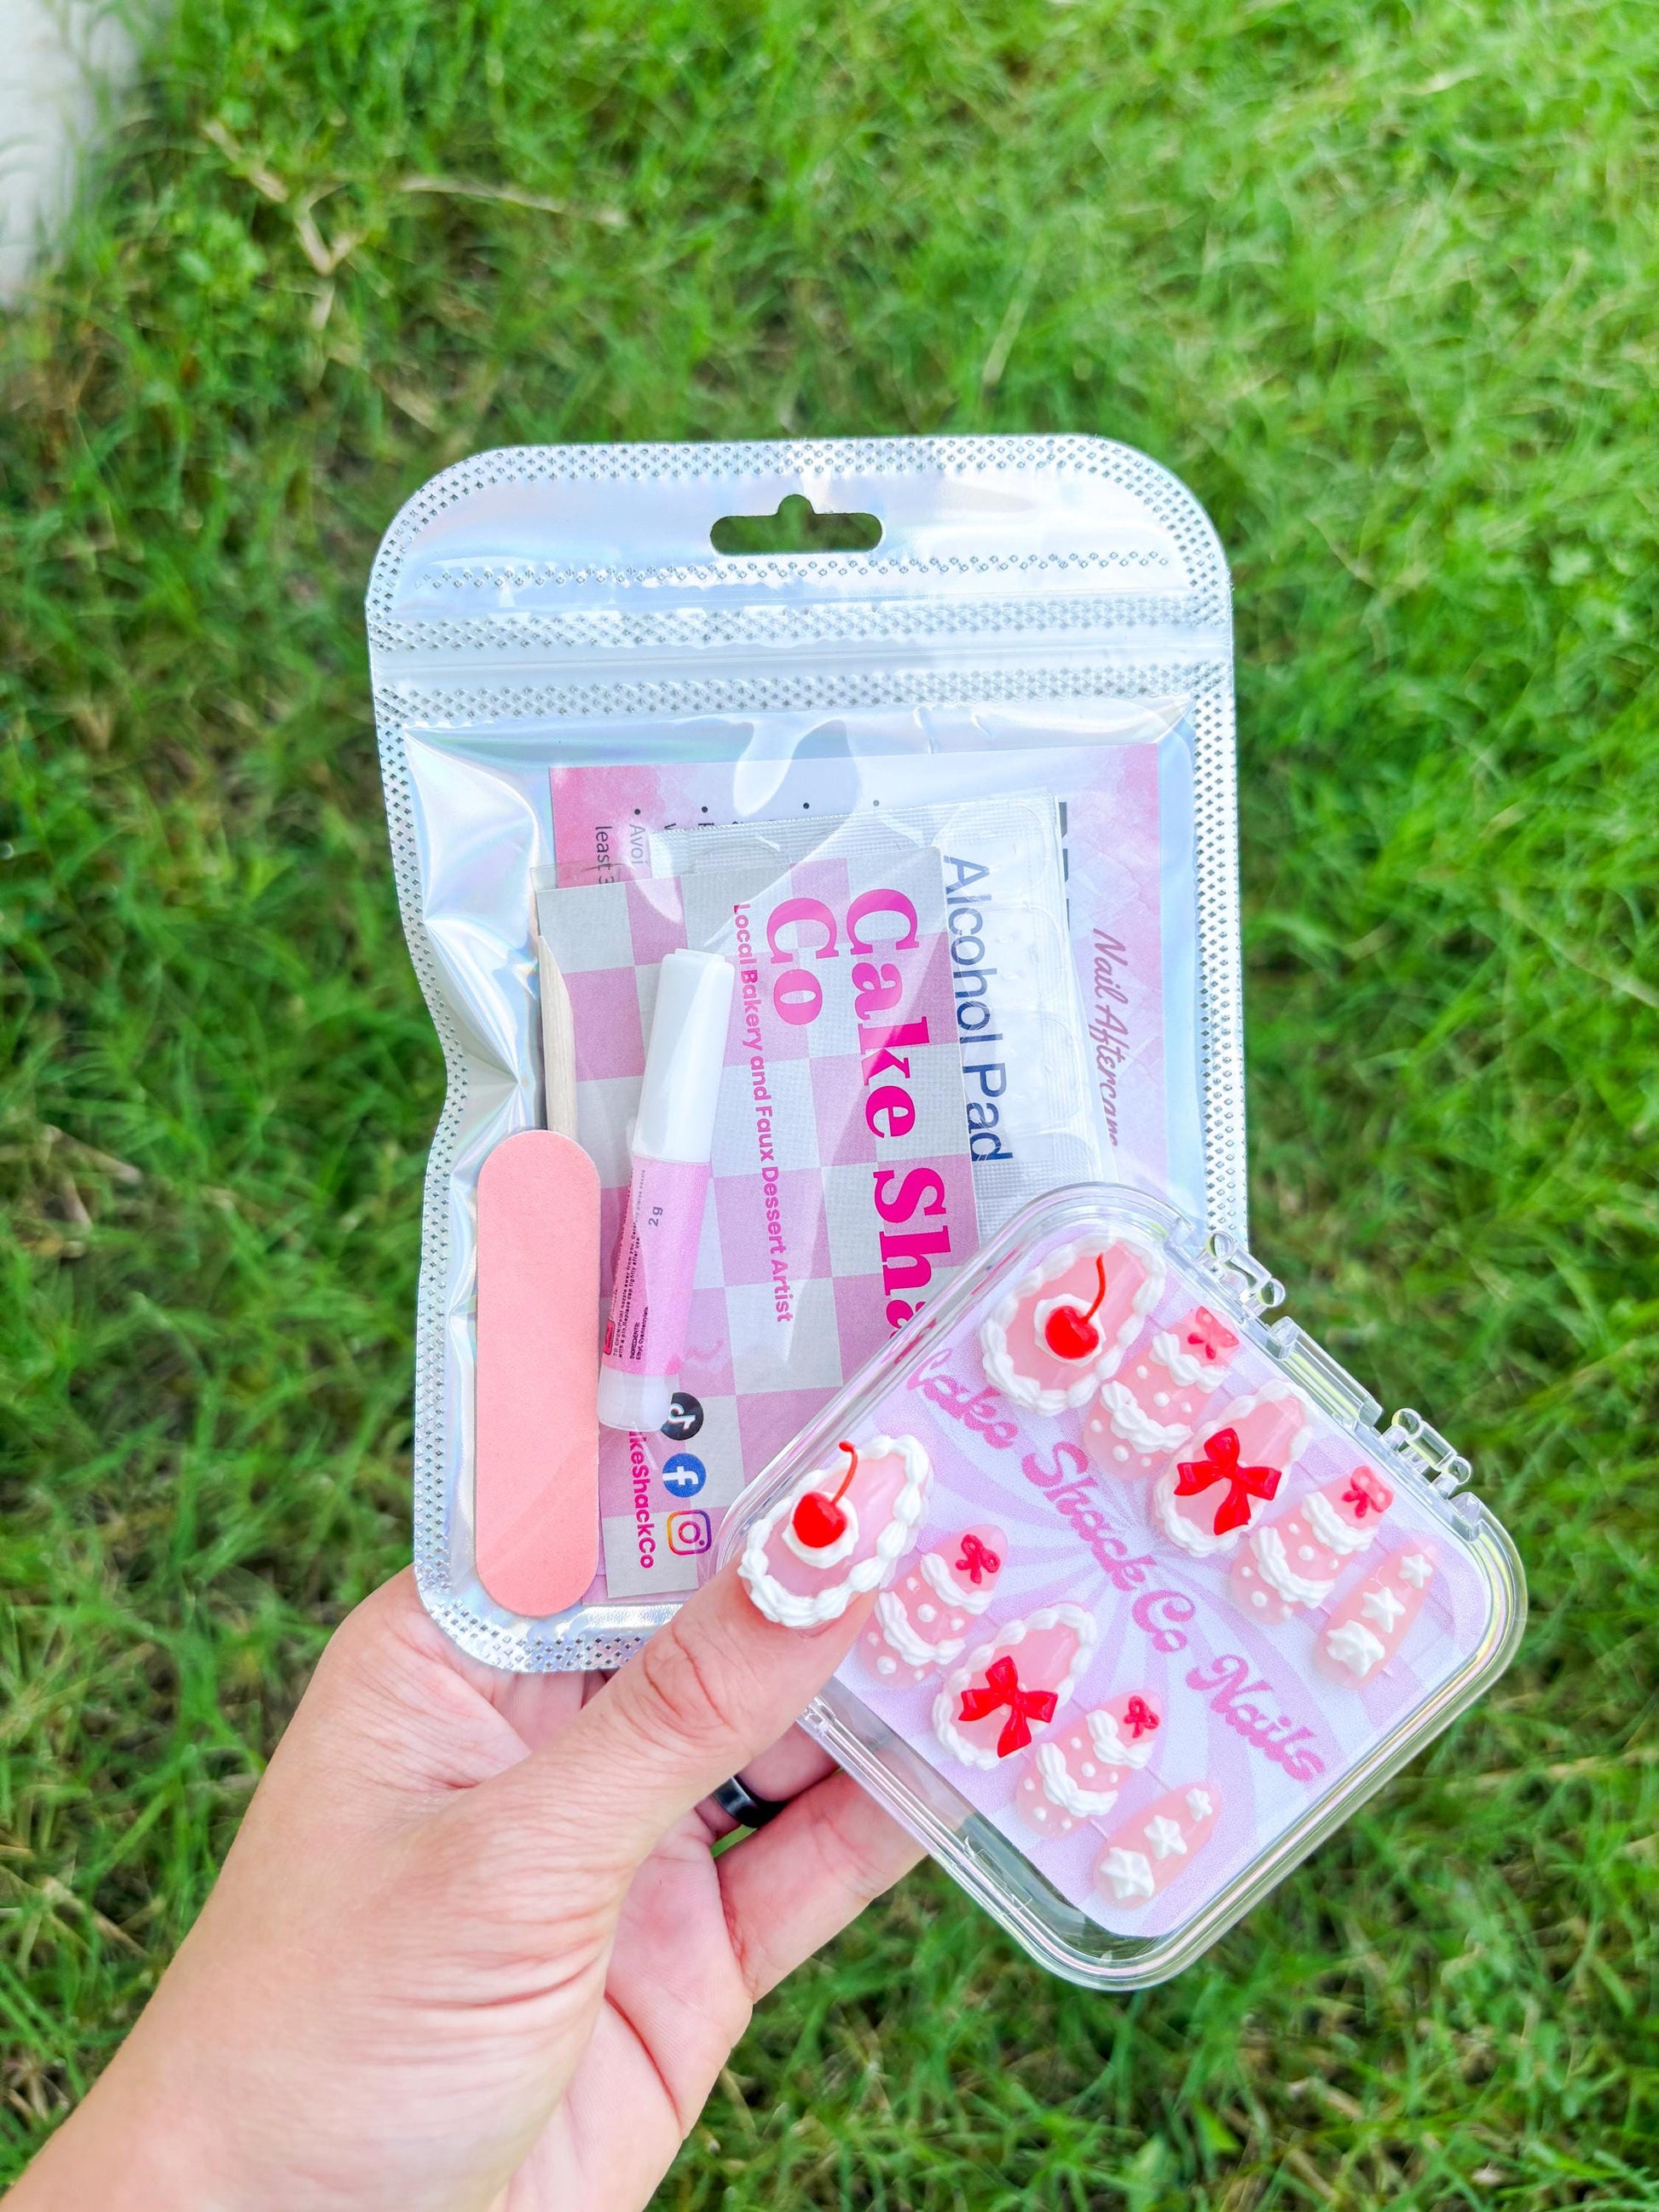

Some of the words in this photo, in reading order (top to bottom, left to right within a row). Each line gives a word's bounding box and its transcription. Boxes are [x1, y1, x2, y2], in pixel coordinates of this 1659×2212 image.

[595, 825, 613, 871] least
[628, 823, 646, 865] Avoi
[733, 904, 757, 965] Local
[766, 898, 840, 1025] Co
[943, 855, 1003, 1045] Alcohol
[1093, 927, 1129, 1004] Nail
[741, 969, 763, 1051] Bakery
[846, 887, 930, 1139] Cake
[750, 1055, 772, 1100] and
[962, 1061, 1014, 1162] Pad
[755, 1106, 774, 1162] Faux
[761, 1166, 786, 1255] Dessert
[771, 1259, 794, 1322] Artist
[873, 1167, 952, 1338] Sha
[1022, 1441, 1158, 1591] Shack
[1131, 1589, 1196, 1654] Co
[1186, 1654, 1325, 1782] Nails
